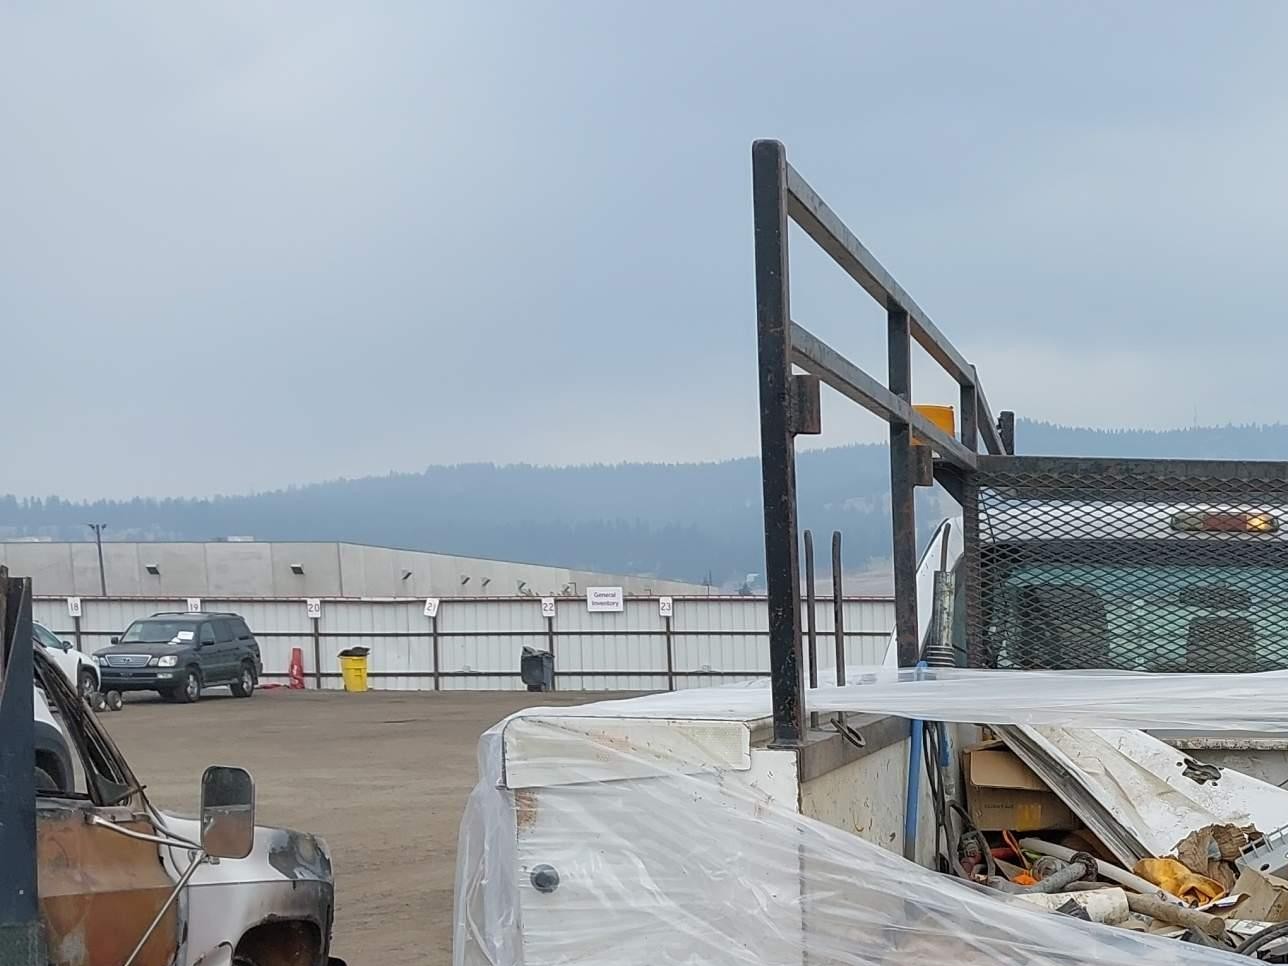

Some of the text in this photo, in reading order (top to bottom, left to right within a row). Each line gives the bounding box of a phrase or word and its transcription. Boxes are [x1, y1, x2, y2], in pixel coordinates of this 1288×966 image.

[70, 602, 79, 611] 18
[190, 603, 199, 611] 19
[308, 603, 320, 613] 20
[426, 602, 437, 612] 21
[543, 602, 555, 612] 22
